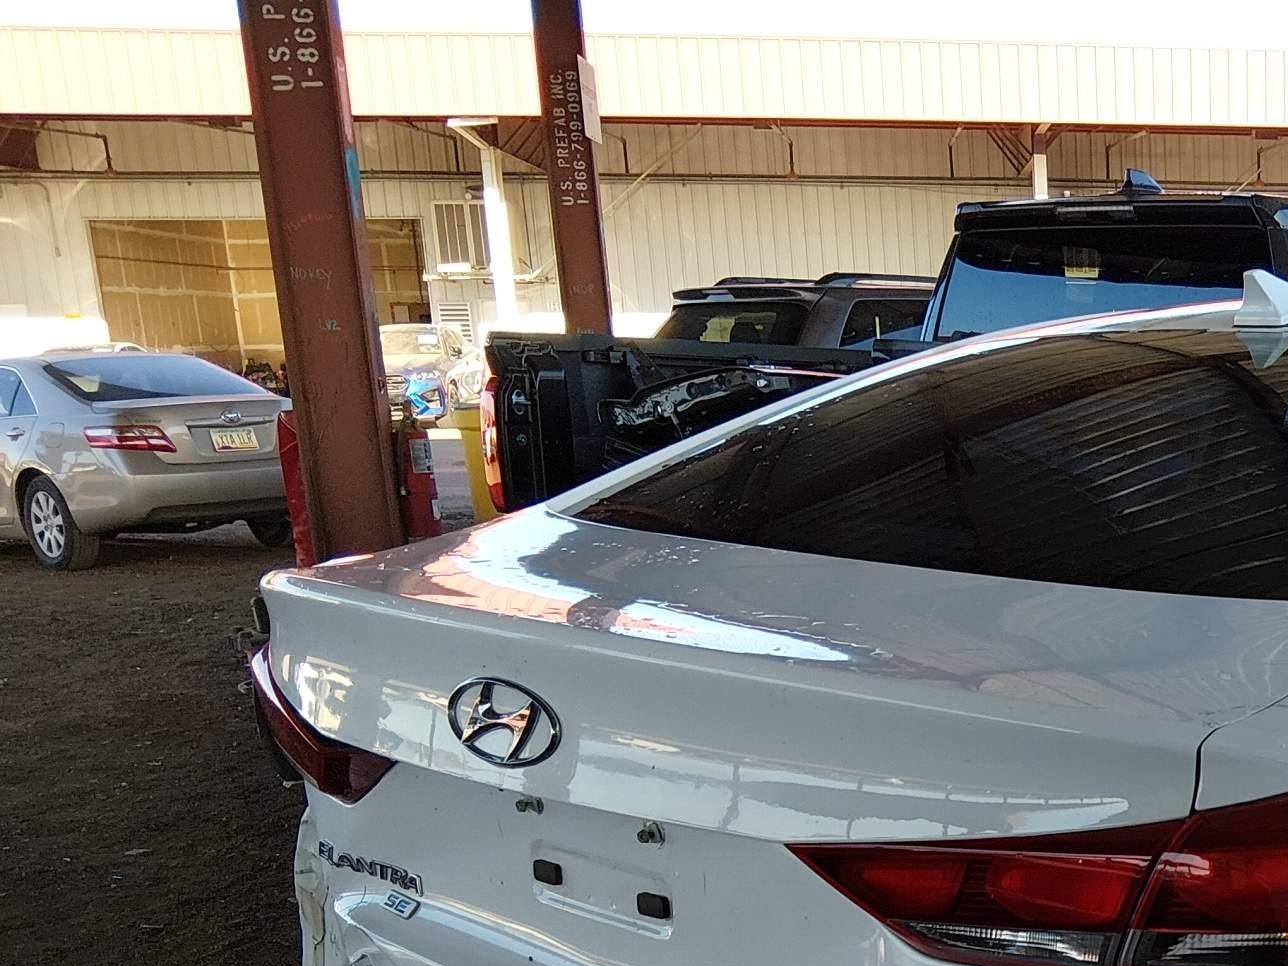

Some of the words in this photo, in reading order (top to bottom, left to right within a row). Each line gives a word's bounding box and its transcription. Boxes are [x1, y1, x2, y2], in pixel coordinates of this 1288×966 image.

[268, 37, 294, 91] U.S.
[291, 0, 324, 88] 1-866
[550, 69, 565, 99] INC.
[553, 107, 571, 168] PREFAB
[565, 71, 590, 204] 1-866-799-0969
[560, 176, 575, 206] U.S.
[319, 839, 423, 897] ELANTRA
[384, 894, 411, 914] SE
